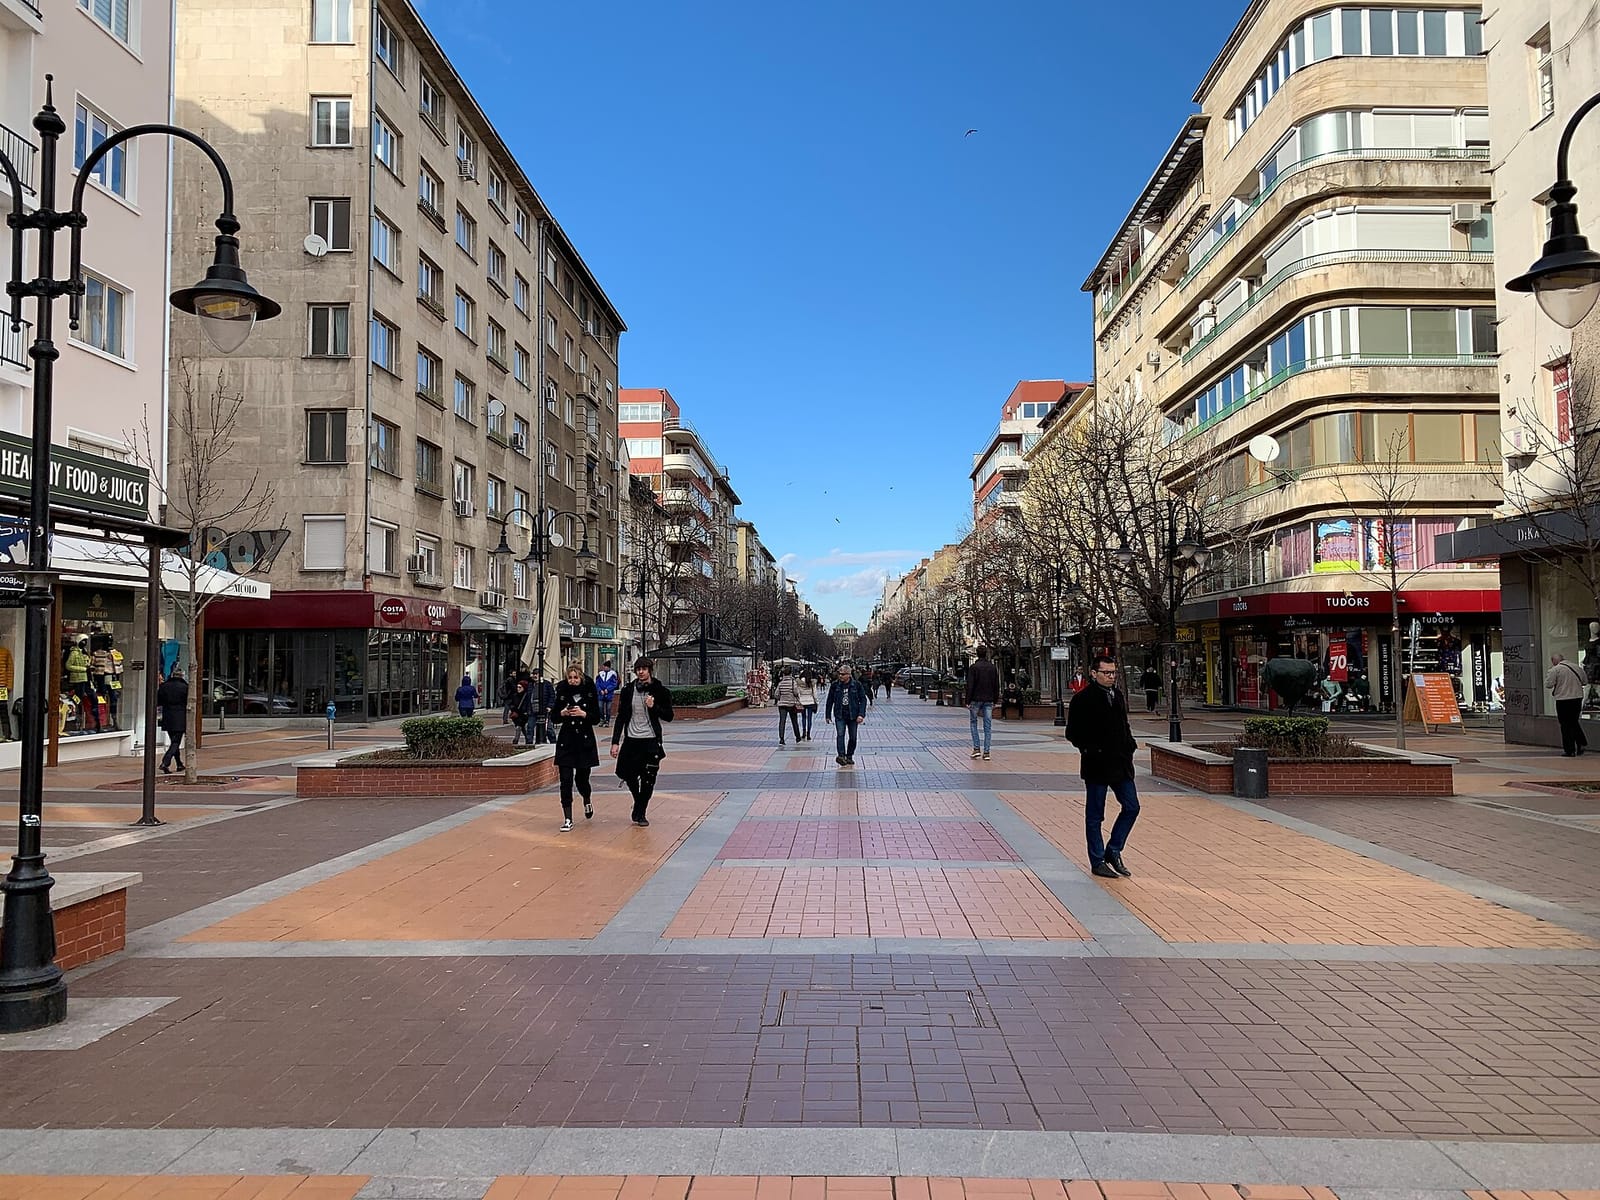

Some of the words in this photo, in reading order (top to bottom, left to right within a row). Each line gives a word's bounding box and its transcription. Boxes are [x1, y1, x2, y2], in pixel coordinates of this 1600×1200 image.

[1, 449, 61, 487] HEAY
[65, 465, 98, 495] FOOD
[99, 477, 108, 493] &
[108, 476, 144, 506] JUICES
[1326, 597, 1370, 607] TUDORS
[427, 605, 446, 619] COSTA
[1422, 616, 1455, 624] TUDORS
[1330, 654, 1347, 671] 70
[1475, 655, 1483, 687] TUDORS
